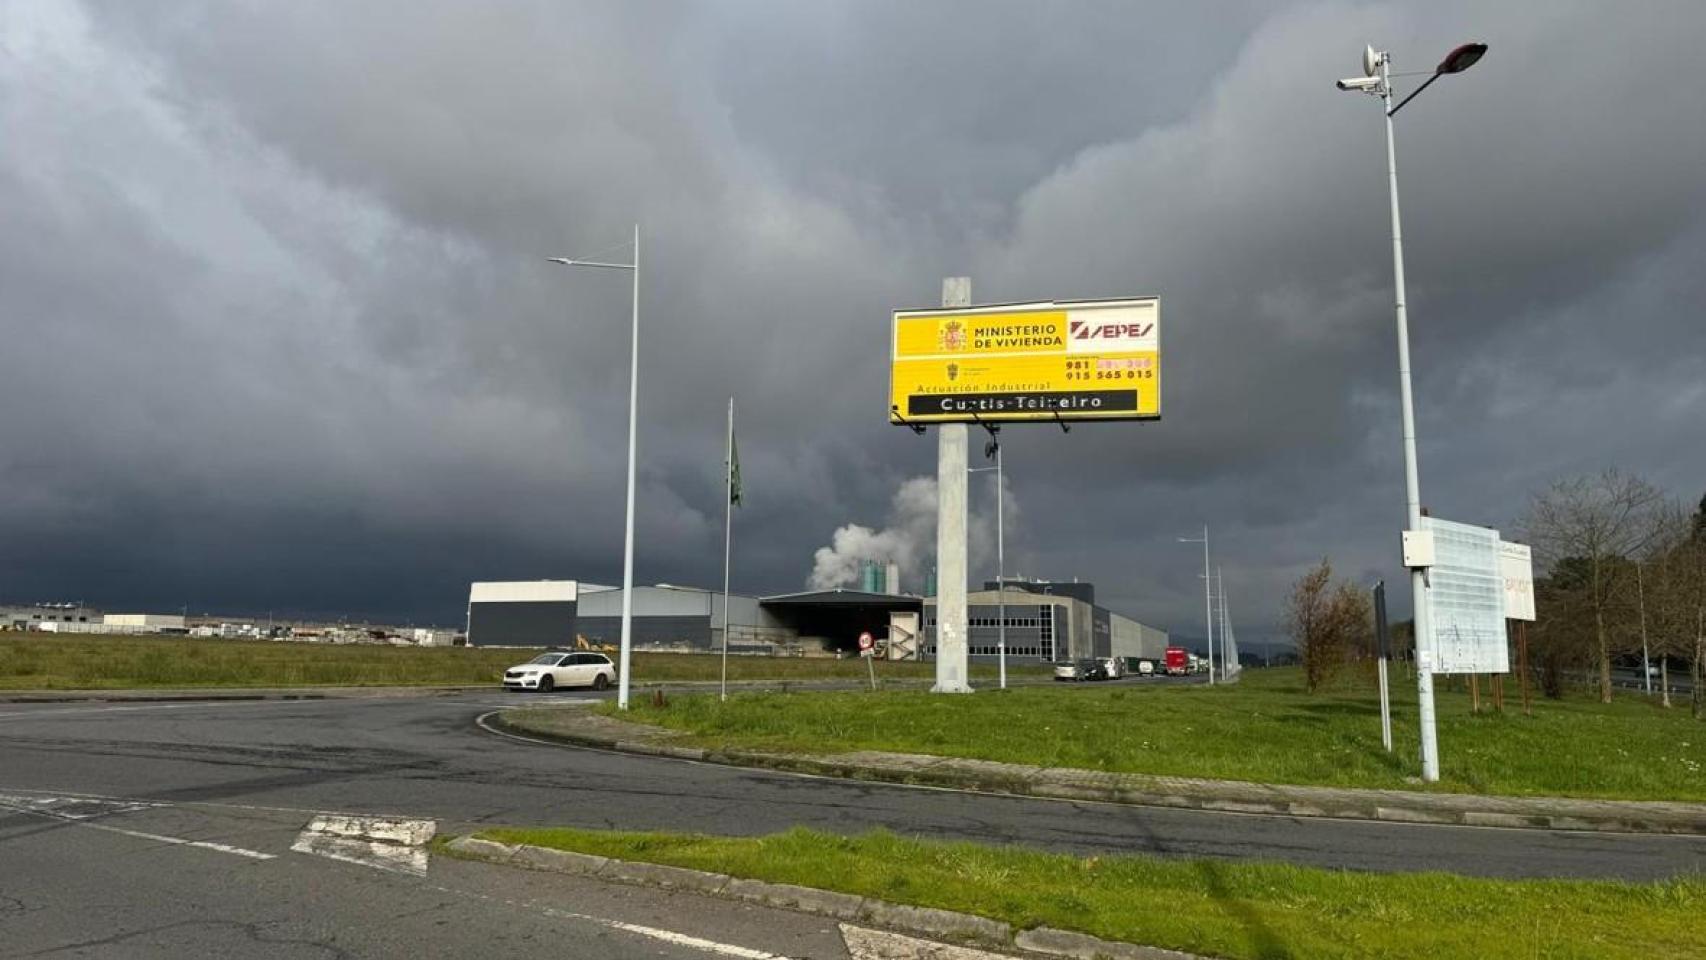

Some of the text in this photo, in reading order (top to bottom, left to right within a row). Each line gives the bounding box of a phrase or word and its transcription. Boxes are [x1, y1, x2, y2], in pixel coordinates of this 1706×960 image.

[974, 325, 1057, 337] MINISTERIO
[974, 336, 1063, 349] DE VIVIENDA
[1065, 361, 1089, 370] 981
[1065, 369, 1153, 380] 915 565 015
[917, 381, 1051, 394] Actuación Industrial
